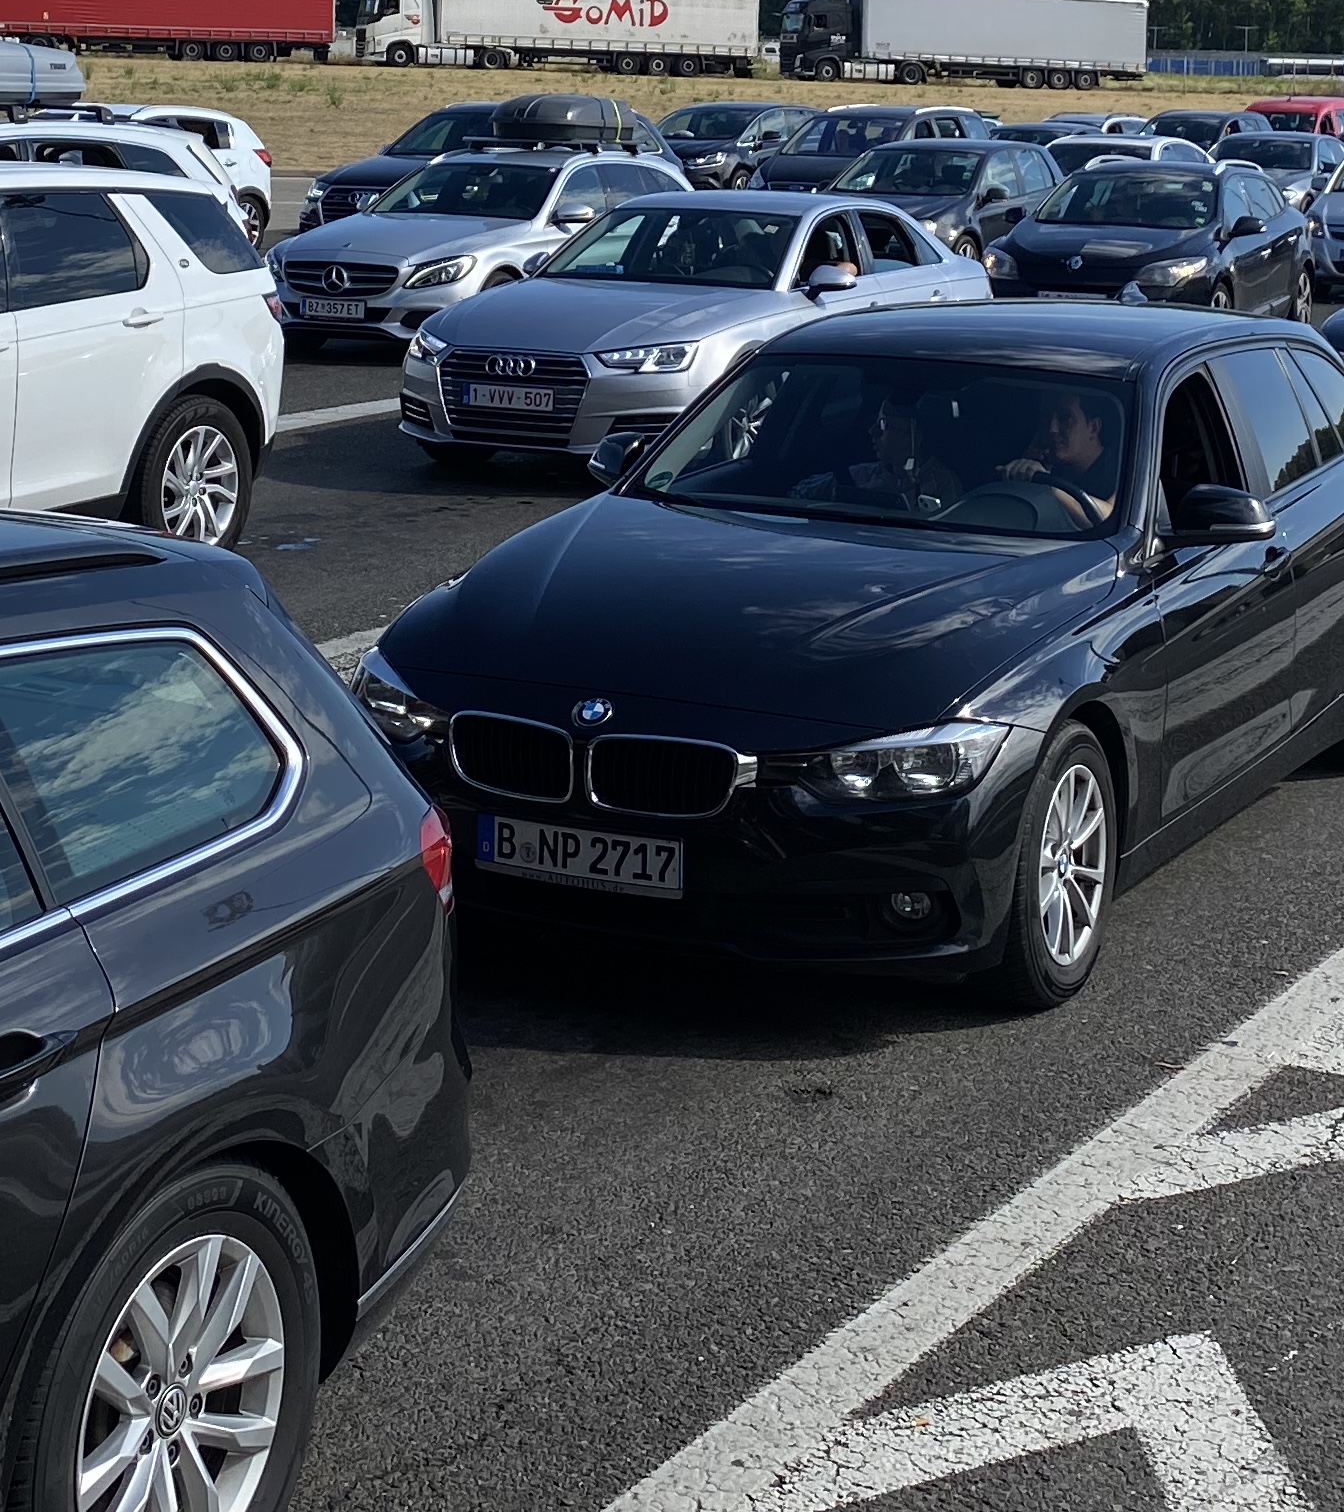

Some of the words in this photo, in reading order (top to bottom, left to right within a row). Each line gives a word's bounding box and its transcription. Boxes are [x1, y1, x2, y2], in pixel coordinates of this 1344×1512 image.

[308, 300, 319, 313] BZ
[326, 302, 345, 314] 357
[347, 303, 359, 316] ET
[482, 840, 490, 852] D
[497, 821, 517, 860] B
[538, 828, 581, 869] NP
[589, 836, 676, 883] 2717
[253, 1191, 309, 1264] KINERGY
